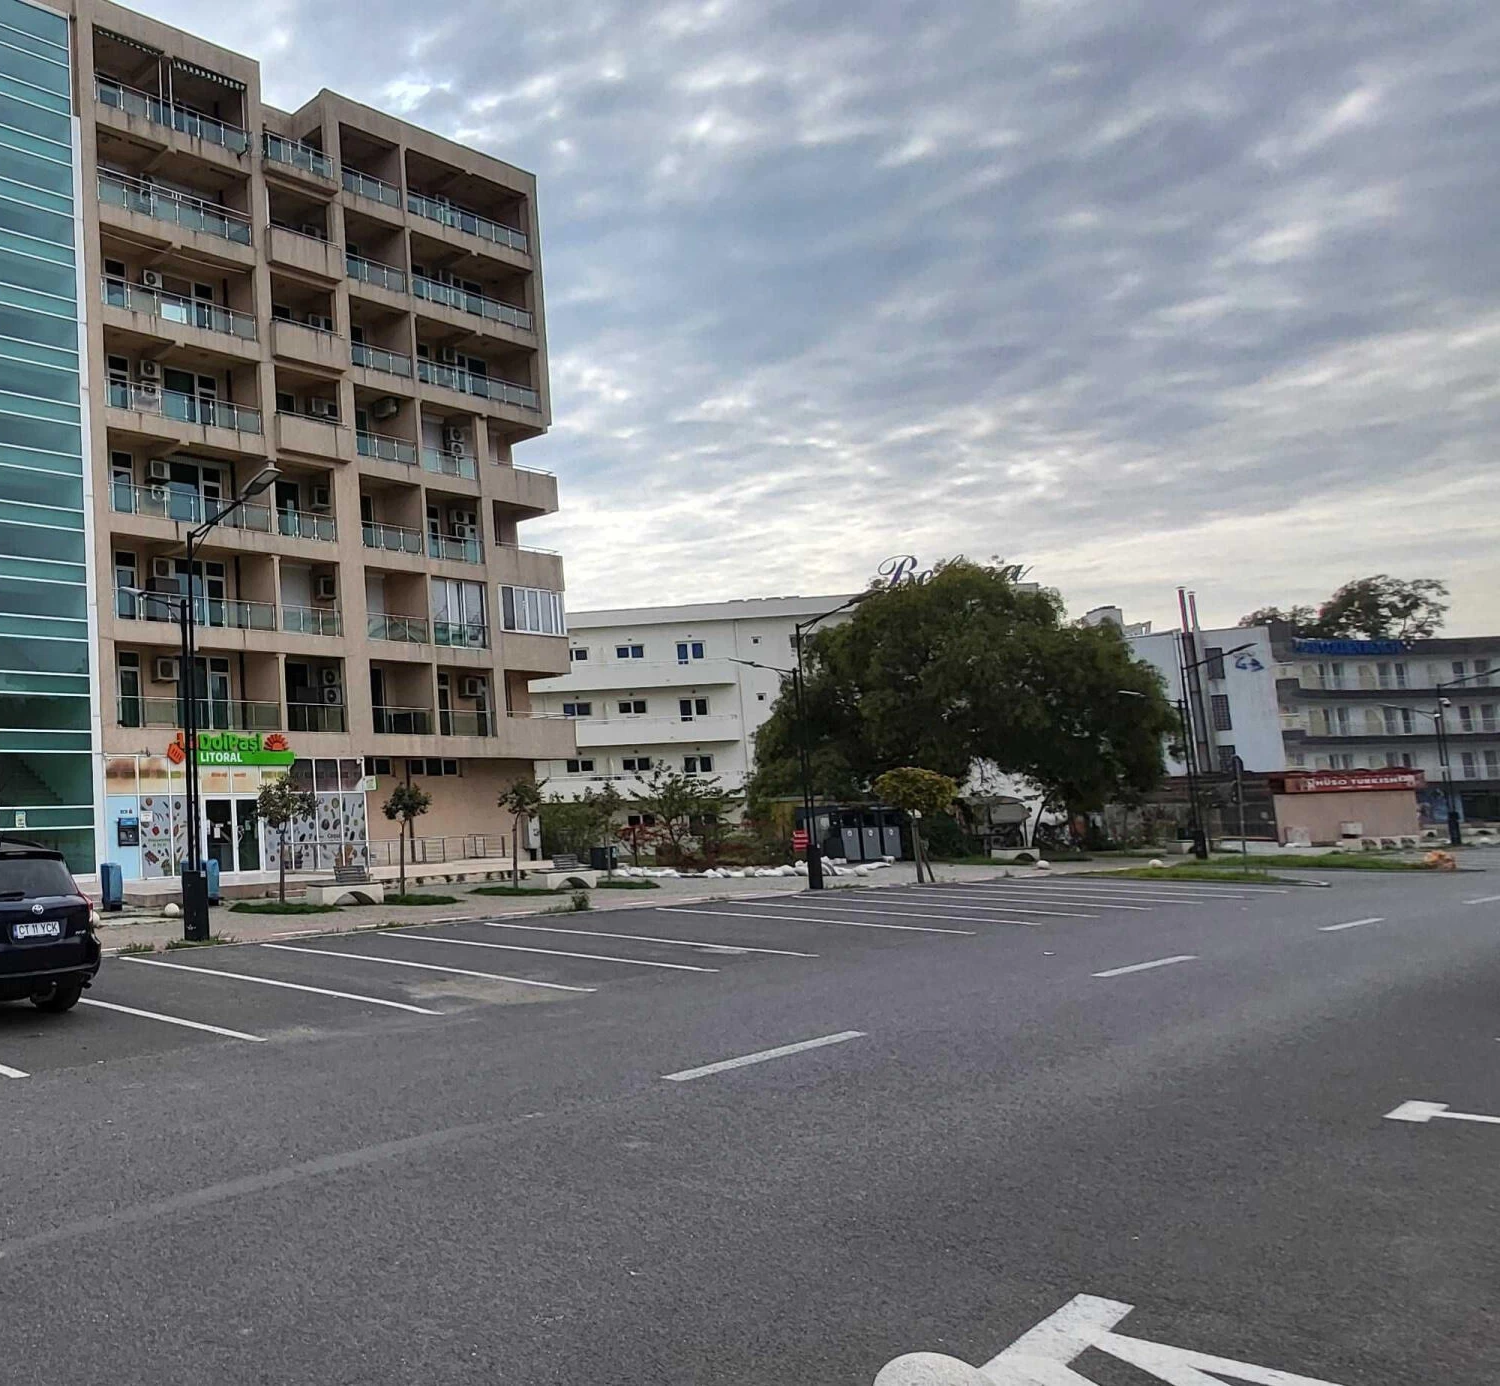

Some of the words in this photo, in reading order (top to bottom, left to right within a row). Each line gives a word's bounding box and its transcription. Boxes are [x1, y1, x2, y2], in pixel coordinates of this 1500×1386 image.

[200, 752, 243, 763] LITORAL
[18, 925, 29, 935] CT
[32, 924, 39, 934] 11
[40, 922, 58, 933] YCK
